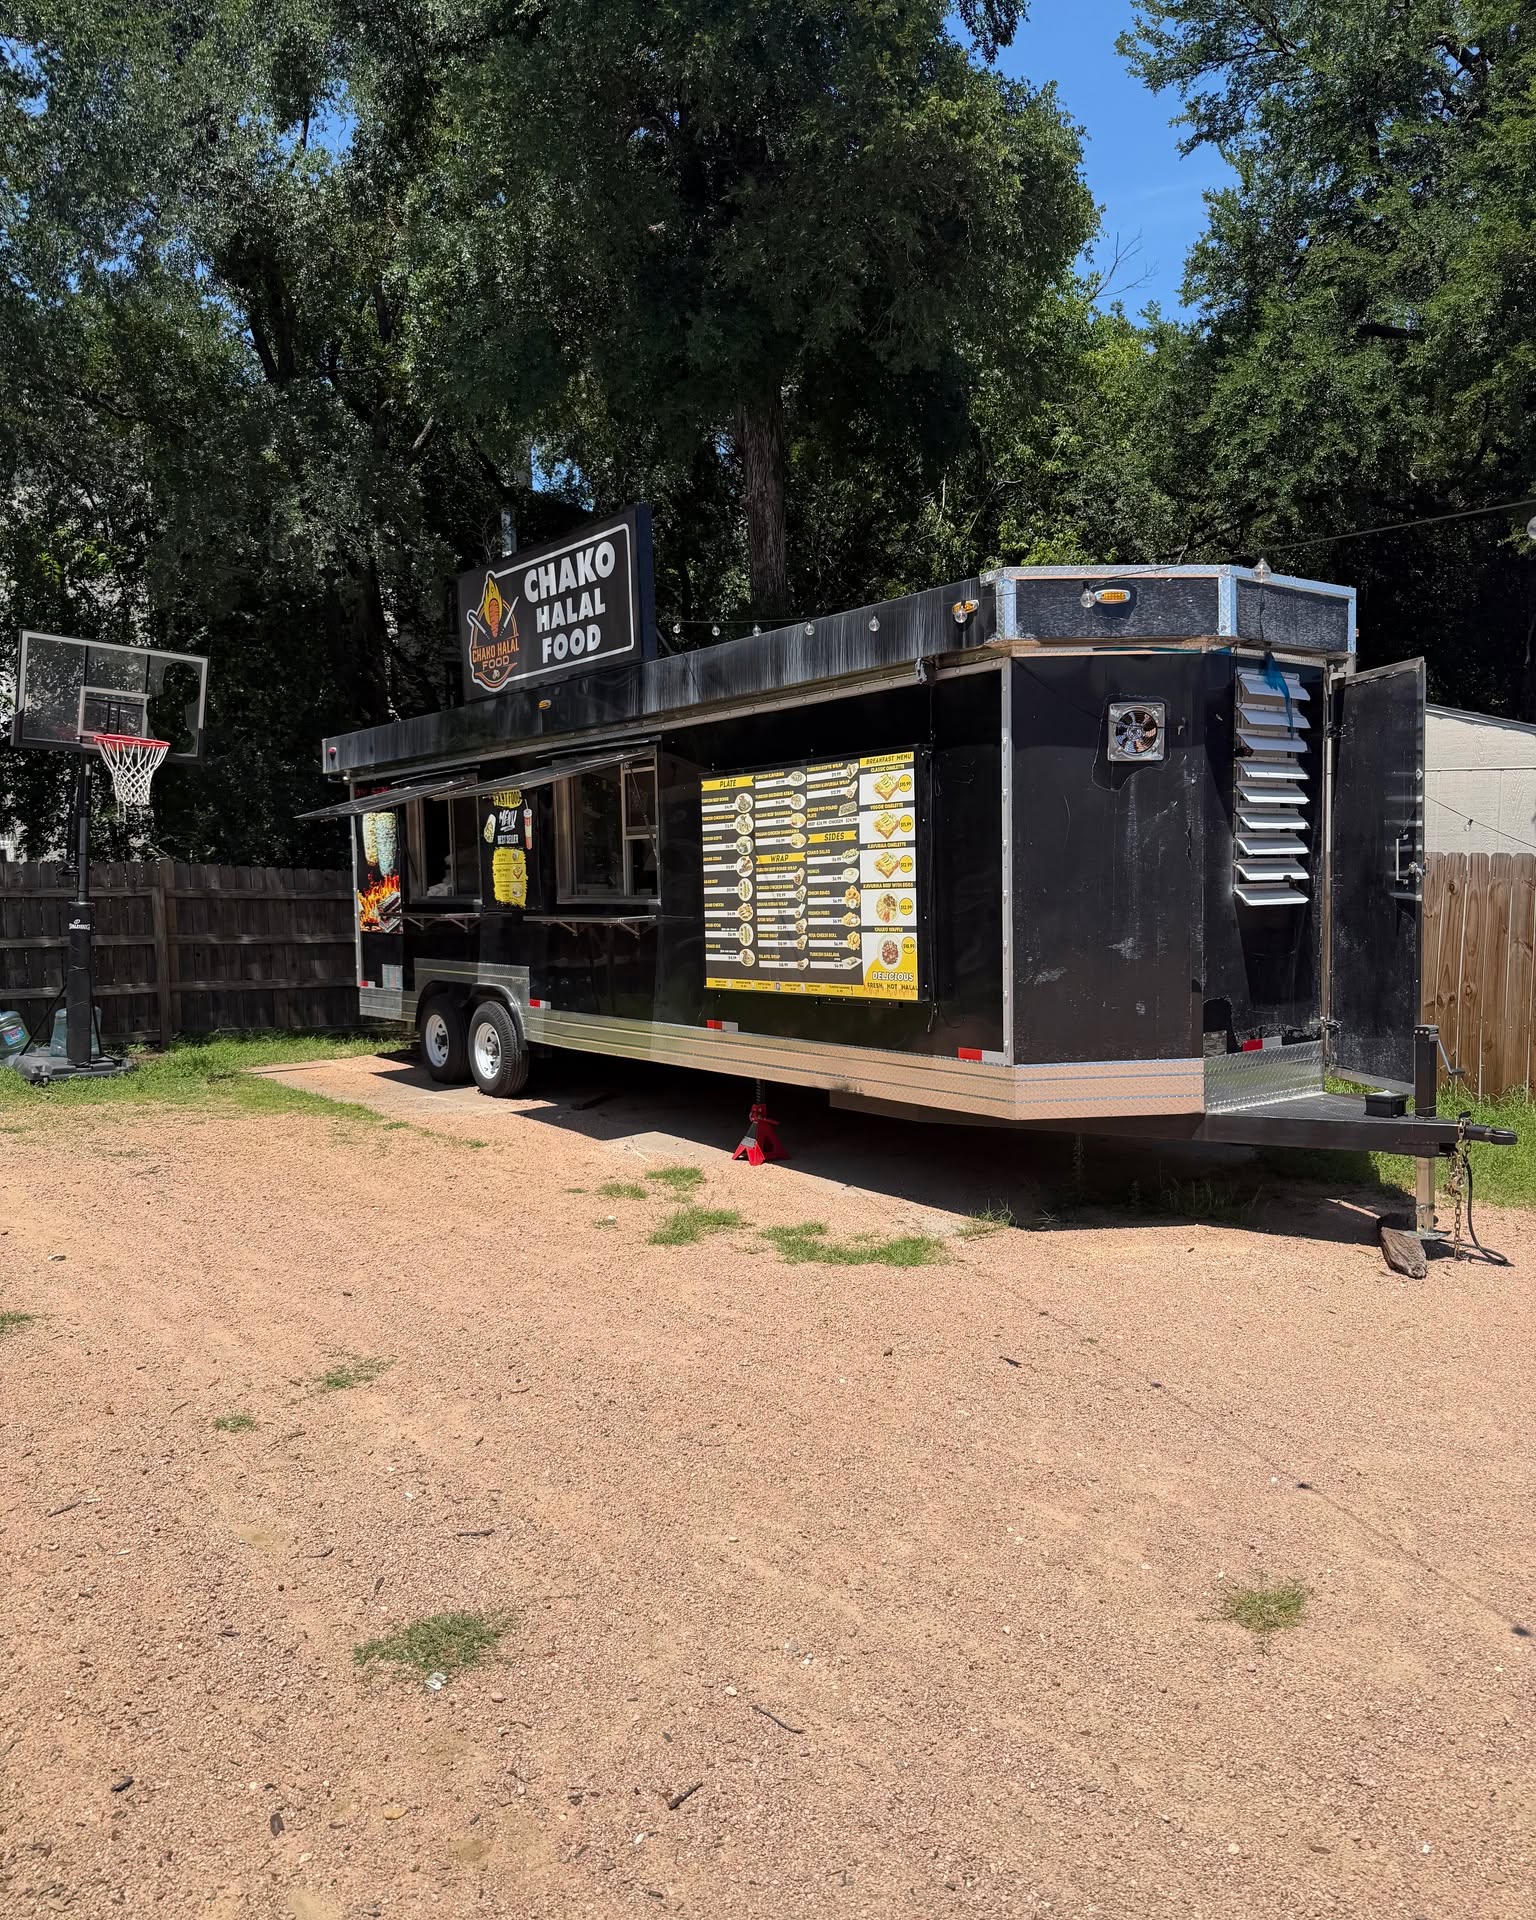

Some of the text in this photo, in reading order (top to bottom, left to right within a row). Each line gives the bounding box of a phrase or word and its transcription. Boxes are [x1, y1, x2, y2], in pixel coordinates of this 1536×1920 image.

[524, 541, 616, 603] CHAKO
[536, 588, 606, 633] HALAL
[472, 639, 520, 663] CHAKO HALAL
[542, 624, 601, 664] FOOD
[482, 656, 510, 671] FOOD
[866, 755, 895, 765] BREAKFAST
[508, 790, 521, 805] FOOD
[499, 810, 518, 827] MENU
[824, 832, 845, 841] SIDES
[872, 970, 914, 982] DELICIOUS
